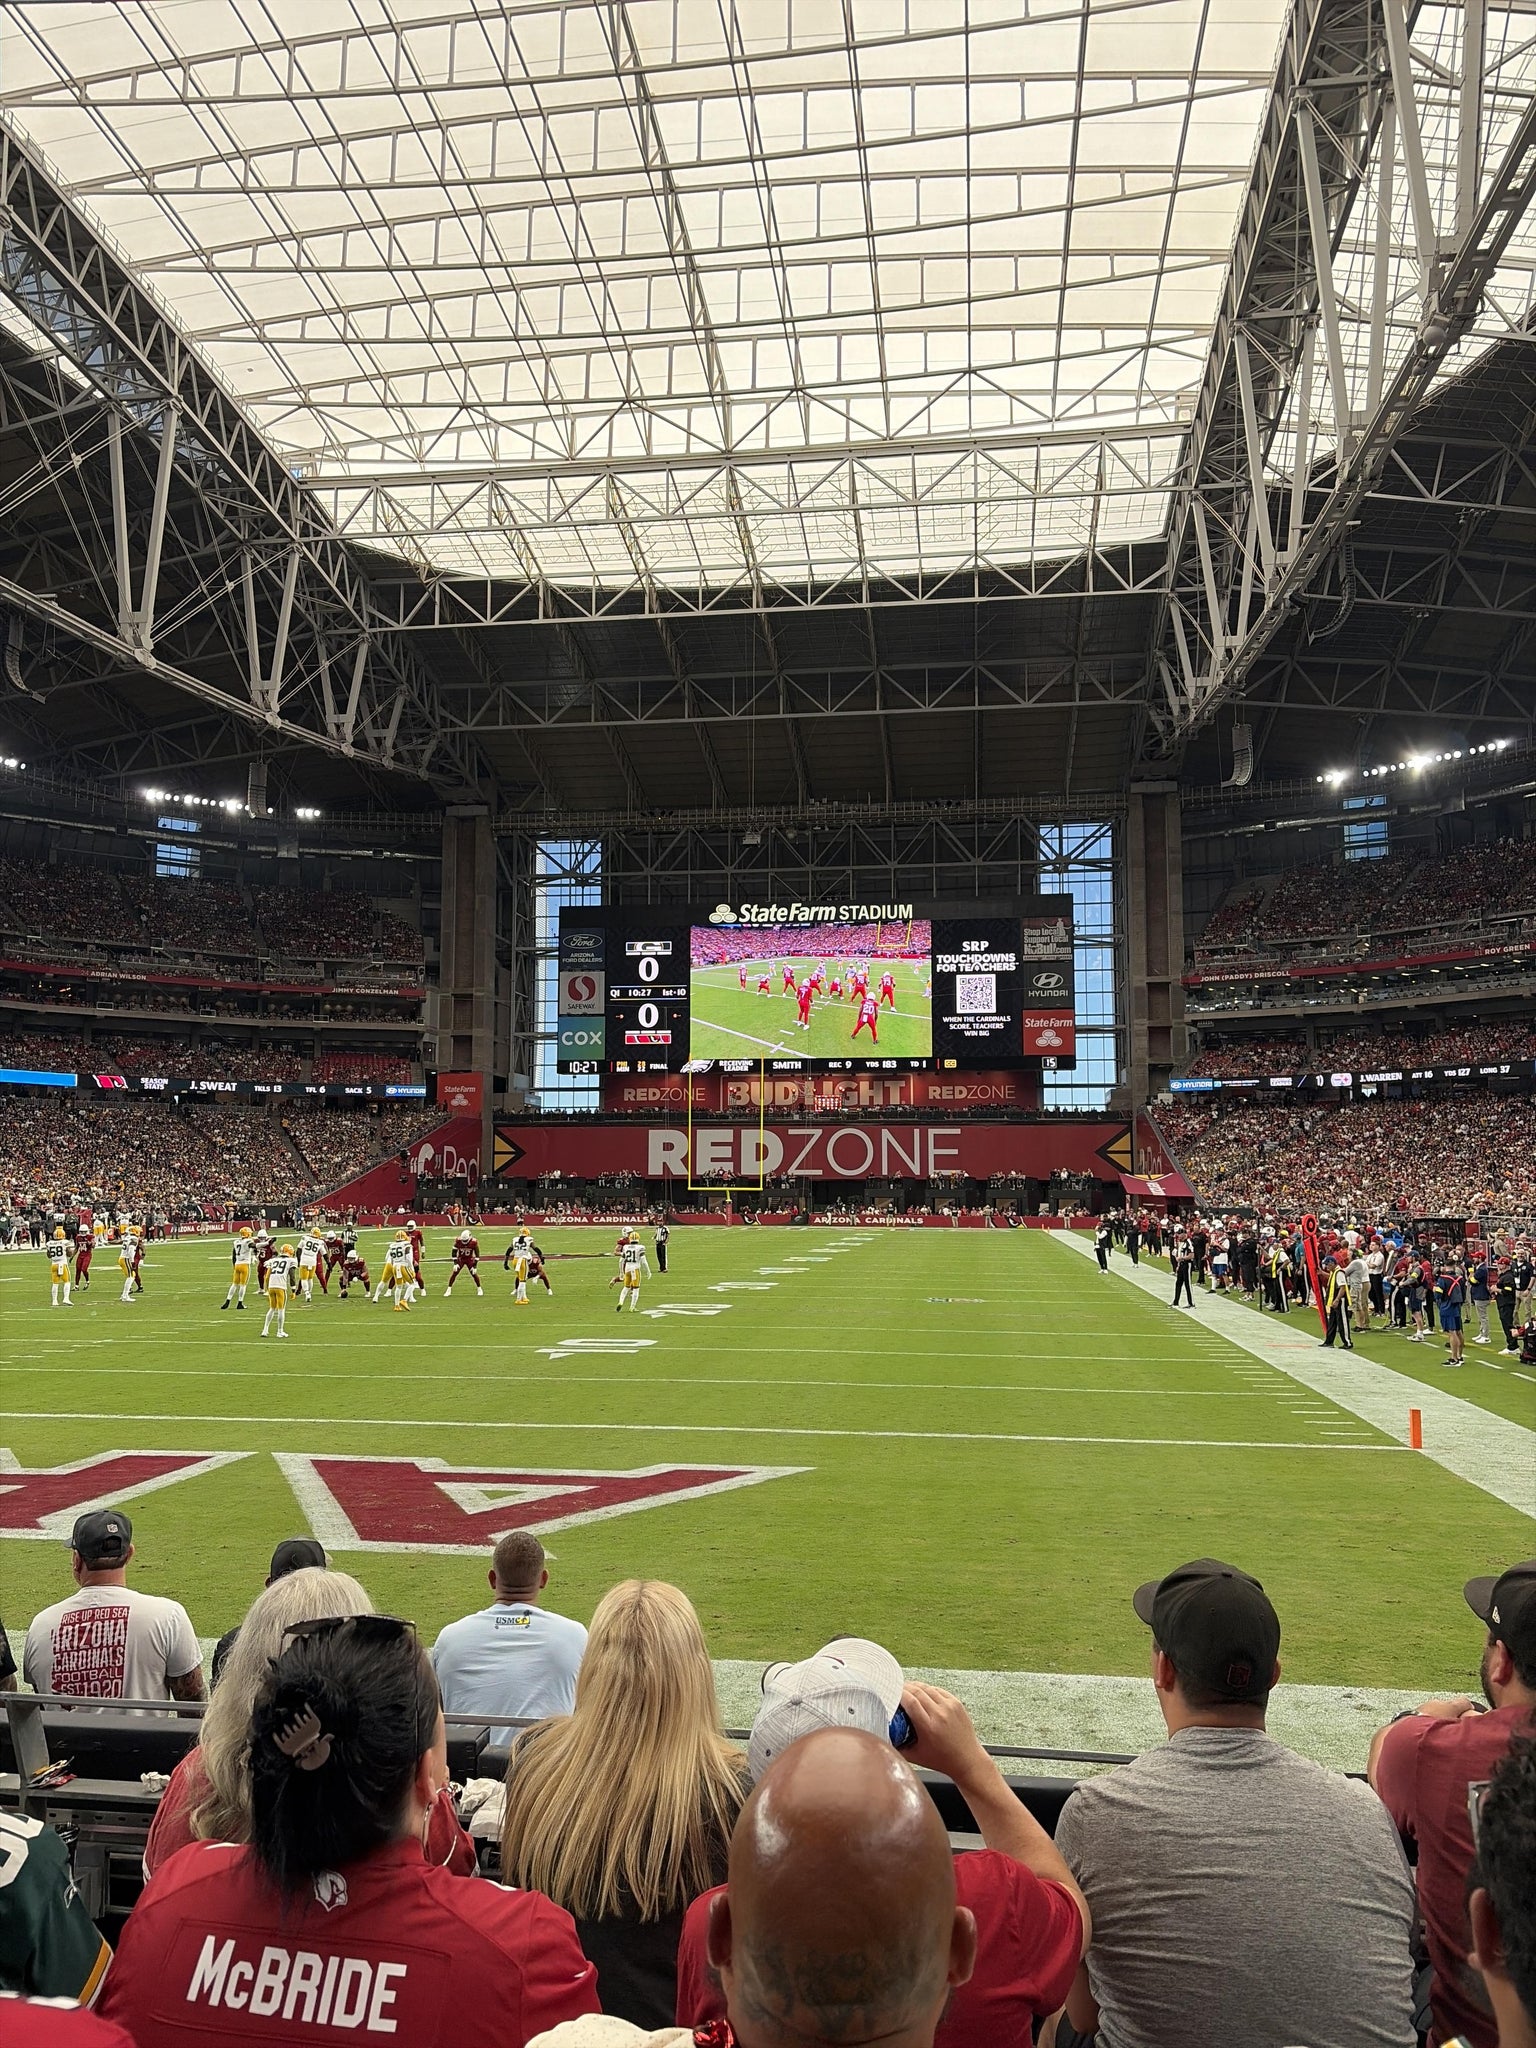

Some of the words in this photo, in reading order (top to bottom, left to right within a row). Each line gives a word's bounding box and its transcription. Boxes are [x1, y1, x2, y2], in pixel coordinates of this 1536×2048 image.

[838, 903, 913, 920] STADIUM
[1023, 928, 1041, 937] Shop
[1041, 928, 1059, 936] Local
[1023, 935, 1051, 944] Support
[1051, 934, 1069, 943] Local
[571, 934, 596, 947] Ford
[961, 940, 990, 952] SRP
[1484, 947, 1501, 955] ROY
[1503, 943, 1531, 953] GREEN
[936, 953, 1016, 964] TOUCHDOWNS
[638, 956, 660, 982] 0
[936, 963, 957, 973] FOR
[90, 970, 118, 978] ADRIAN
[119, 973, 147, 981] WILSON
[1200, 975, 1220, 983] JOHN
[1254, 970, 1291, 979] DRISCOLL
[610, 988, 620, 998] Q1
[628, 988, 652, 997] 10:27
[638, 1003, 660, 1028] 0
[862, 1004, 875, 1014] 20
[561, 1030, 602, 1046] COX
[569, 1061, 598, 1073] 10:27
[772, 1061, 802, 1070] SMITH
[845, 1060, 853, 1069] 9
[882, 1060, 897, 1069] 183
[1424, 1070, 1434, 1079] 16
[1443, 1070, 1457, 1078] YDS
[1457, 1067, 1471, 1077] 127
[1480, 1067, 1498, 1075] LONG
[1500, 1065, 1511, 1074] 37
[140, 1077, 169, 1085] SEASON
[189, 1081, 198, 1090] J.
[199, 1081, 238, 1092] SWEAT
[273, 1085, 282, 1093] 13
[305, 1086, 318, 1094] TFL
[319, 1085, 326, 1094] 6
[366, 1086, 372, 1094] 5
[623, 1087, 706, 1101] REDZONE
[727, 1081, 799, 1106] BUD
[928, 1085, 1016, 1099] REDZONE
[647, 1127, 962, 1176] REDZONE
[49, 1246, 63, 1257] 58
[304, 1240, 319, 1253] 96
[626, 1250, 637, 1263] 21
[271, 1260, 287, 1275] 29
[62, 1612, 80, 1625] RISE
[81, 1609, 93, 1622] UP
[94, 1608, 111, 1620] RED
[112, 1607, 128, 1619] SEA
[495, 1616, 521, 1624] USMC
[51, 1618, 126, 1653] ARIZONA
[54, 1646, 124, 1673] CARDINALS
[54, 1668, 123, 1683] FOOTBALL
[186, 1934, 408, 2034] McBRIDE
